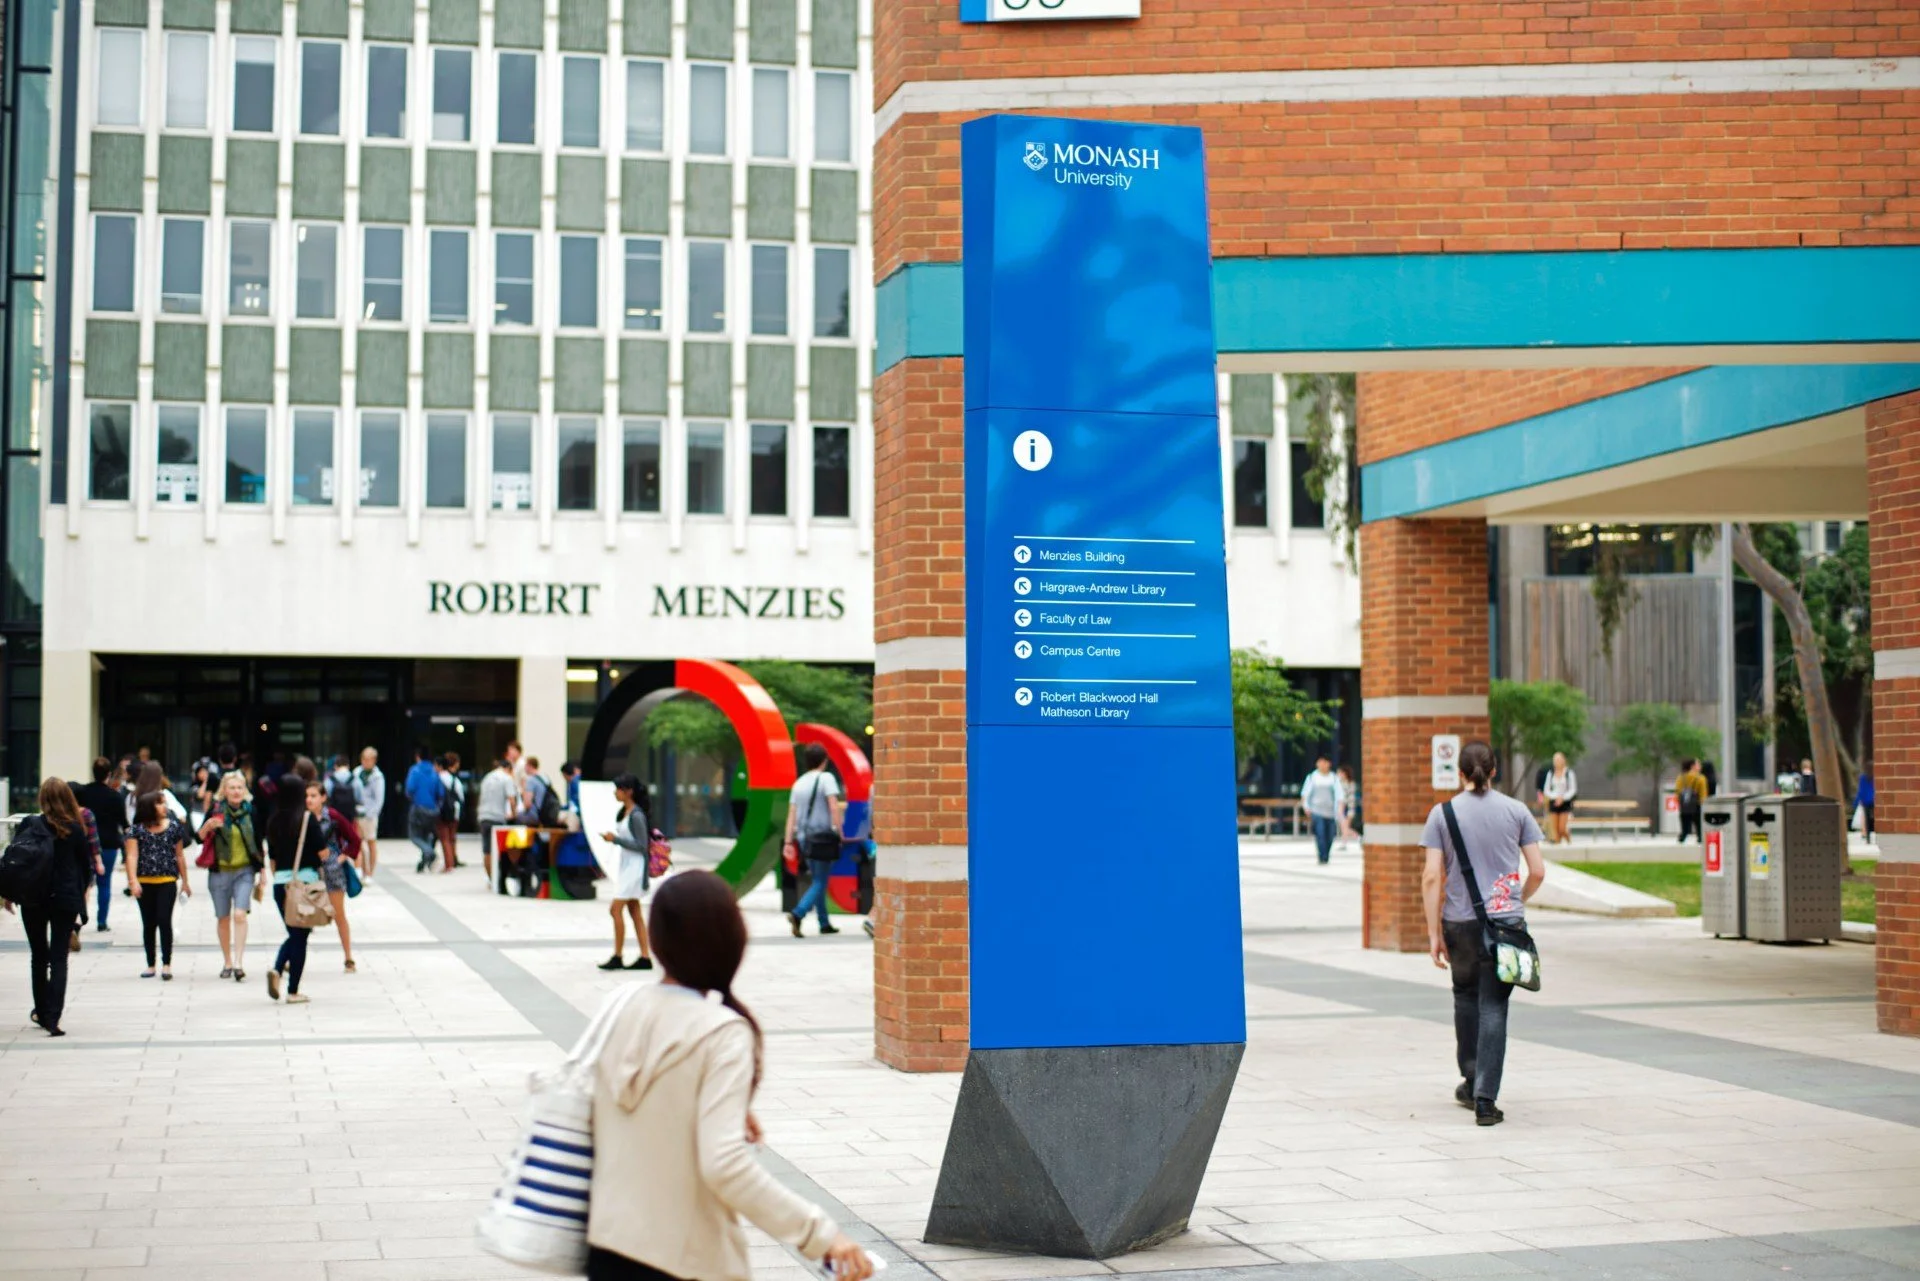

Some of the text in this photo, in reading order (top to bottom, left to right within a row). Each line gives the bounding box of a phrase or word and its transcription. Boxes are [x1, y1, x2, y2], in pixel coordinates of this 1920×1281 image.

[1054, 143, 1159, 169] MONASH
[1054, 168, 1133, 190] University
[1039, 550, 1125, 564] Menzies Building
[1039, 582, 1166, 597] Hargrave-Andrew Library
[428, 581, 846, 620] ROBERT MENZIES
[1039, 612, 1112, 626] Faculty of Law
[1040, 645, 1121, 658] Campus Centre
[1040, 691, 1159, 704] Robert Blackwood Hall
[1040, 706, 1130, 720] Matheson Library
